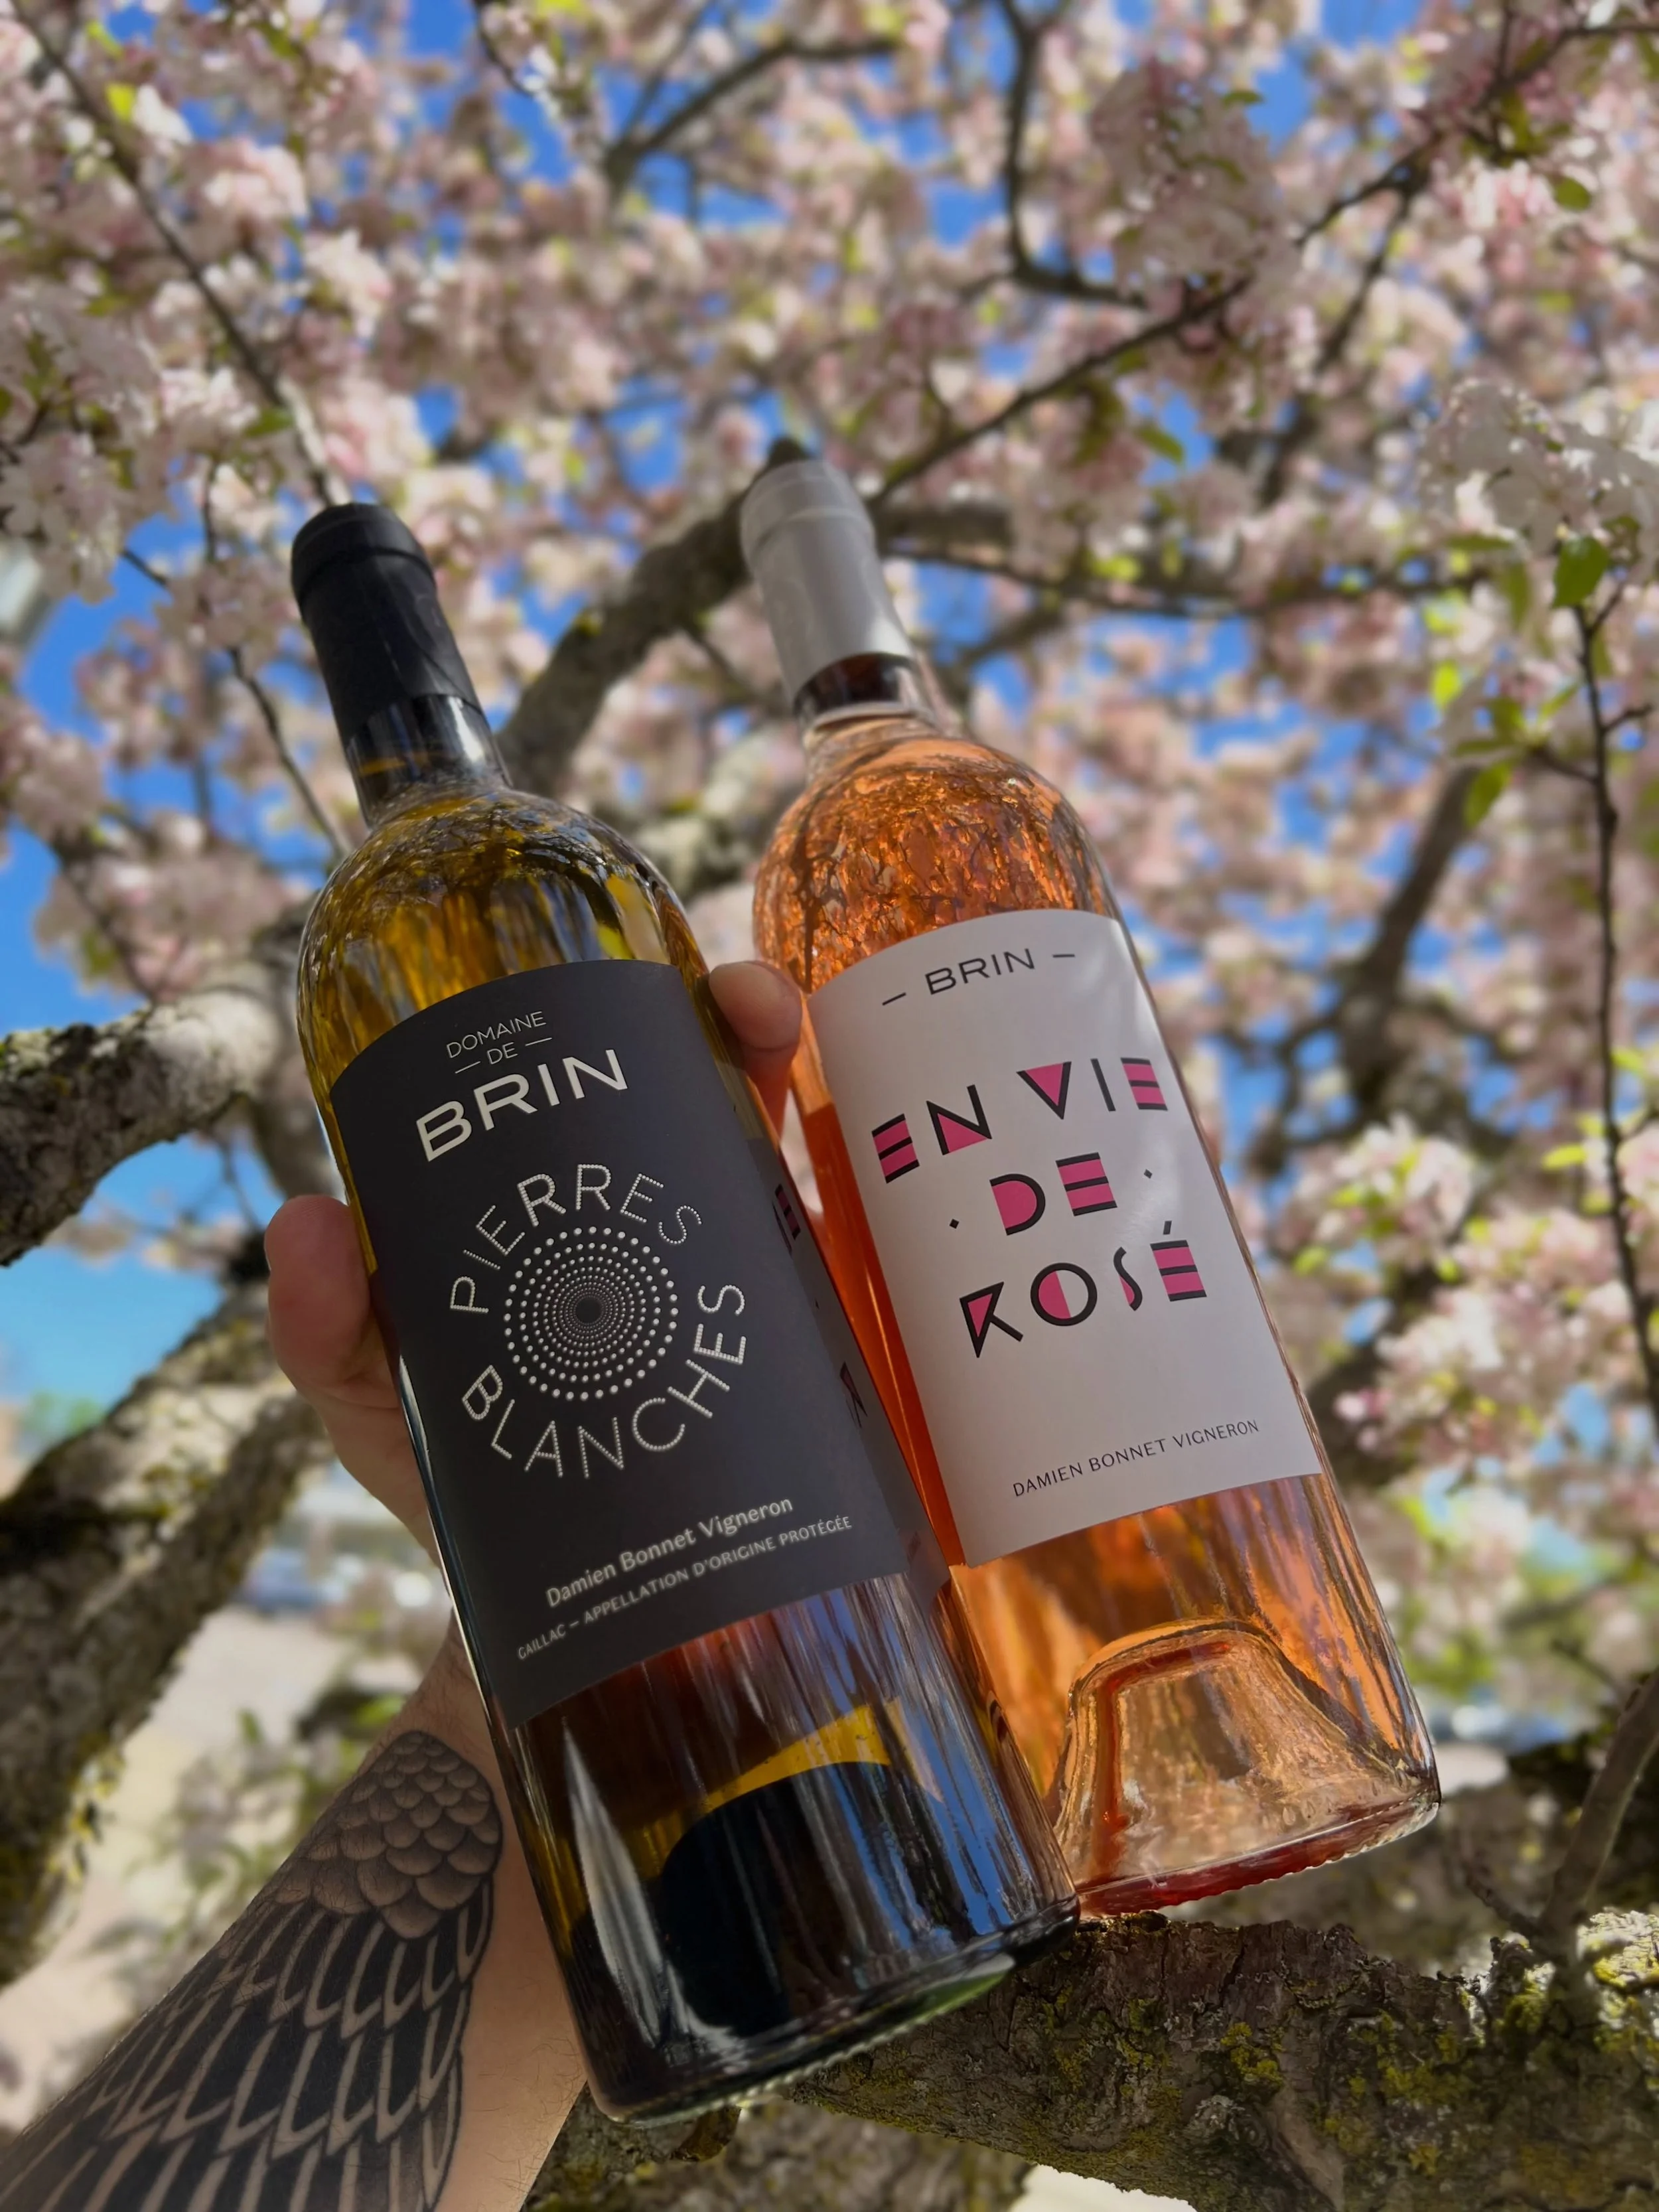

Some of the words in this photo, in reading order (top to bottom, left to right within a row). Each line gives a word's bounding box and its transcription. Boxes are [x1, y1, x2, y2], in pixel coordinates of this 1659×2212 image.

[924, 948, 1035, 995] BRIN
[446, 1011, 547, 1059] DOMAINE
[486, 1041, 518, 1065] DE
[416, 1049, 628, 1161] BRIN
[449, 1163, 703, 1313] PIERRES
[989, 1152, 1118, 1236] DE
[960, 1220, 1207, 1358] ROSÉ
[462, 1284, 747, 1479] BLANCHES
[1013, 1462, 1084, 1497] DAMIEN
[1089, 1438, 1166, 1472] BONNET
[1173, 1420, 1260, 1449] VIGNERON
[517, 1624, 567, 1660] GAILLAC
[583, 1569, 689, 1624] APPELLATION
[692, 1536, 777, 1578] D'ORIGINE
[778, 1515, 853, 1548] PROTÉGÉE
[545, 1562, 616, 1607] Damien
[619, 1528, 696, 1572] Bonnet
[698, 1498, 794, 1536] Vigneron
